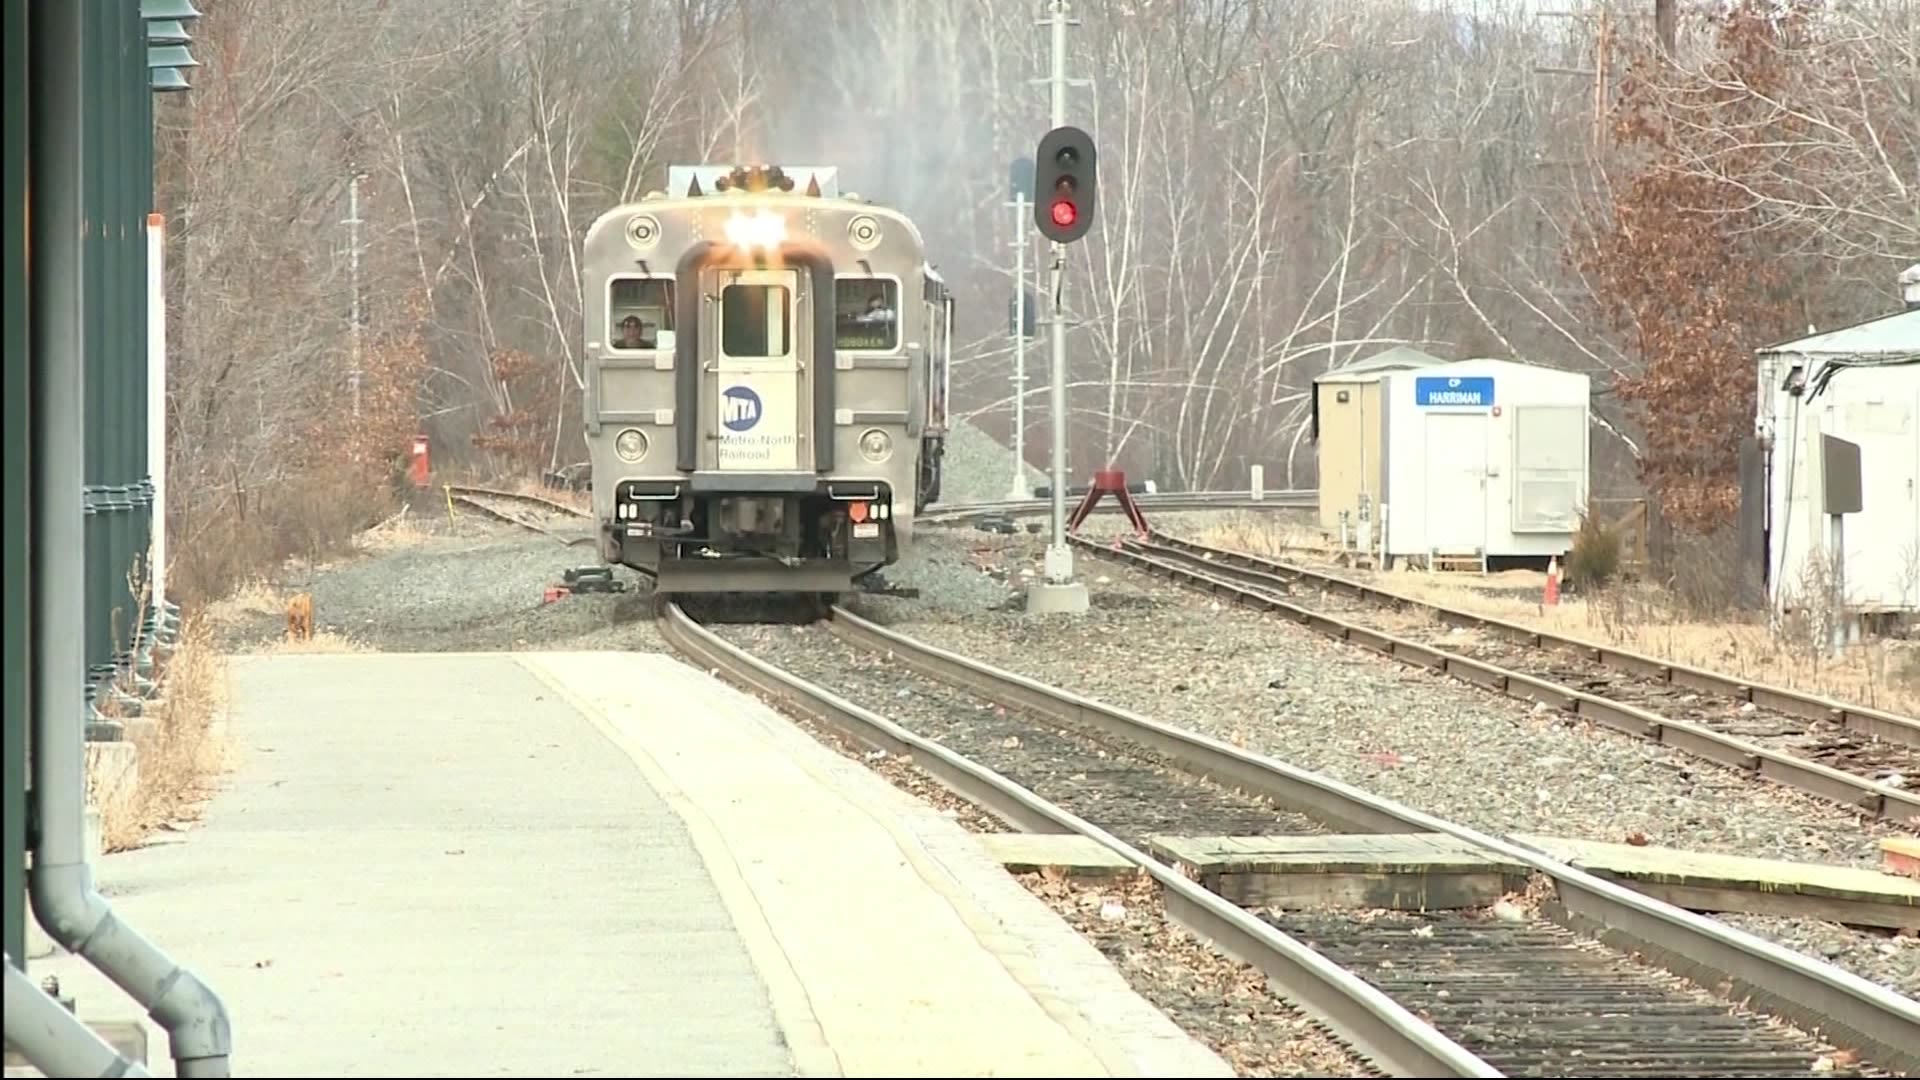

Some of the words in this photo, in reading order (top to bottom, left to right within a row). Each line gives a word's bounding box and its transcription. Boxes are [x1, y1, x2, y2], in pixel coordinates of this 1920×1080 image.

[1448, 379, 1461, 387] CP
[1428, 391, 1482, 404] HARRIMAN
[722, 395, 757, 422] MTA
[719, 435, 796, 445] Metro-North
[719, 448, 770, 459] Railroad
